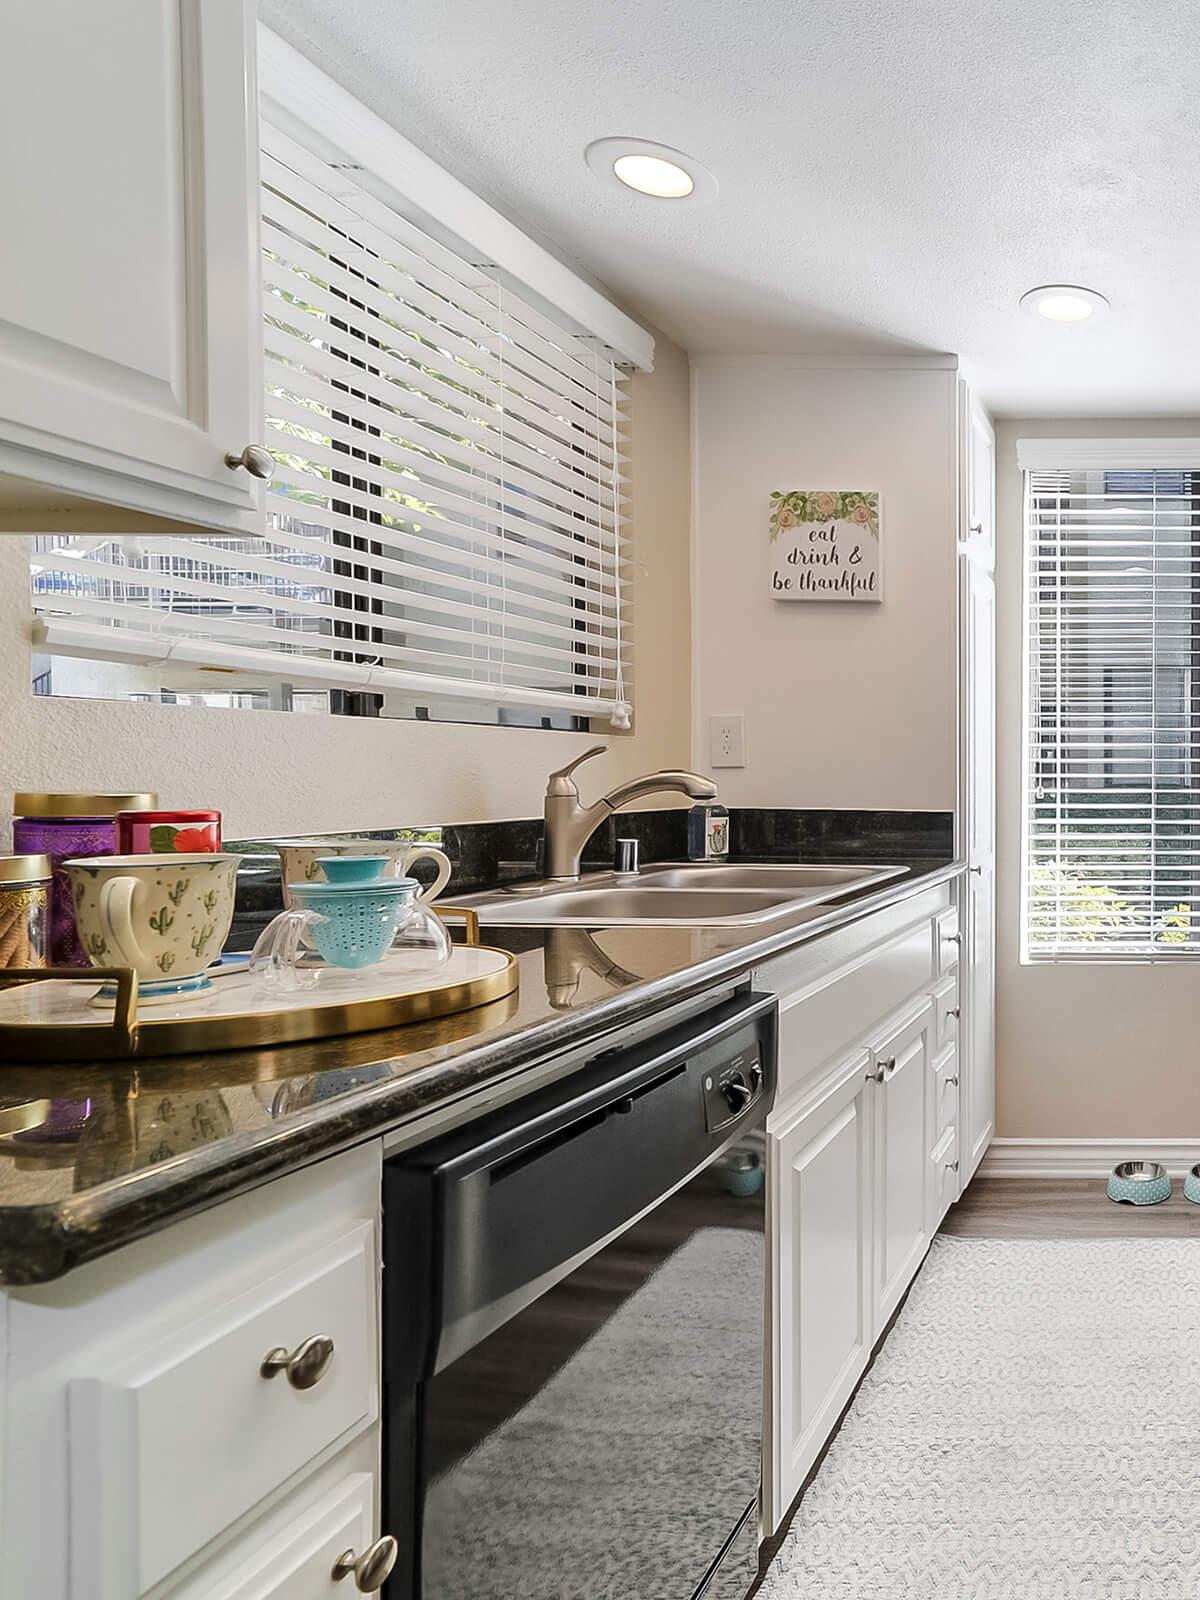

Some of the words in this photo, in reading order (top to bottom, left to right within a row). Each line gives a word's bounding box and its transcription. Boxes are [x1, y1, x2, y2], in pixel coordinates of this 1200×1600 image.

[809, 525, 836, 542] eat
[787, 545, 839, 565] drink
[848, 545, 862, 564] &
[772, 570, 793, 591] be
[799, 570, 877, 596] thankful
